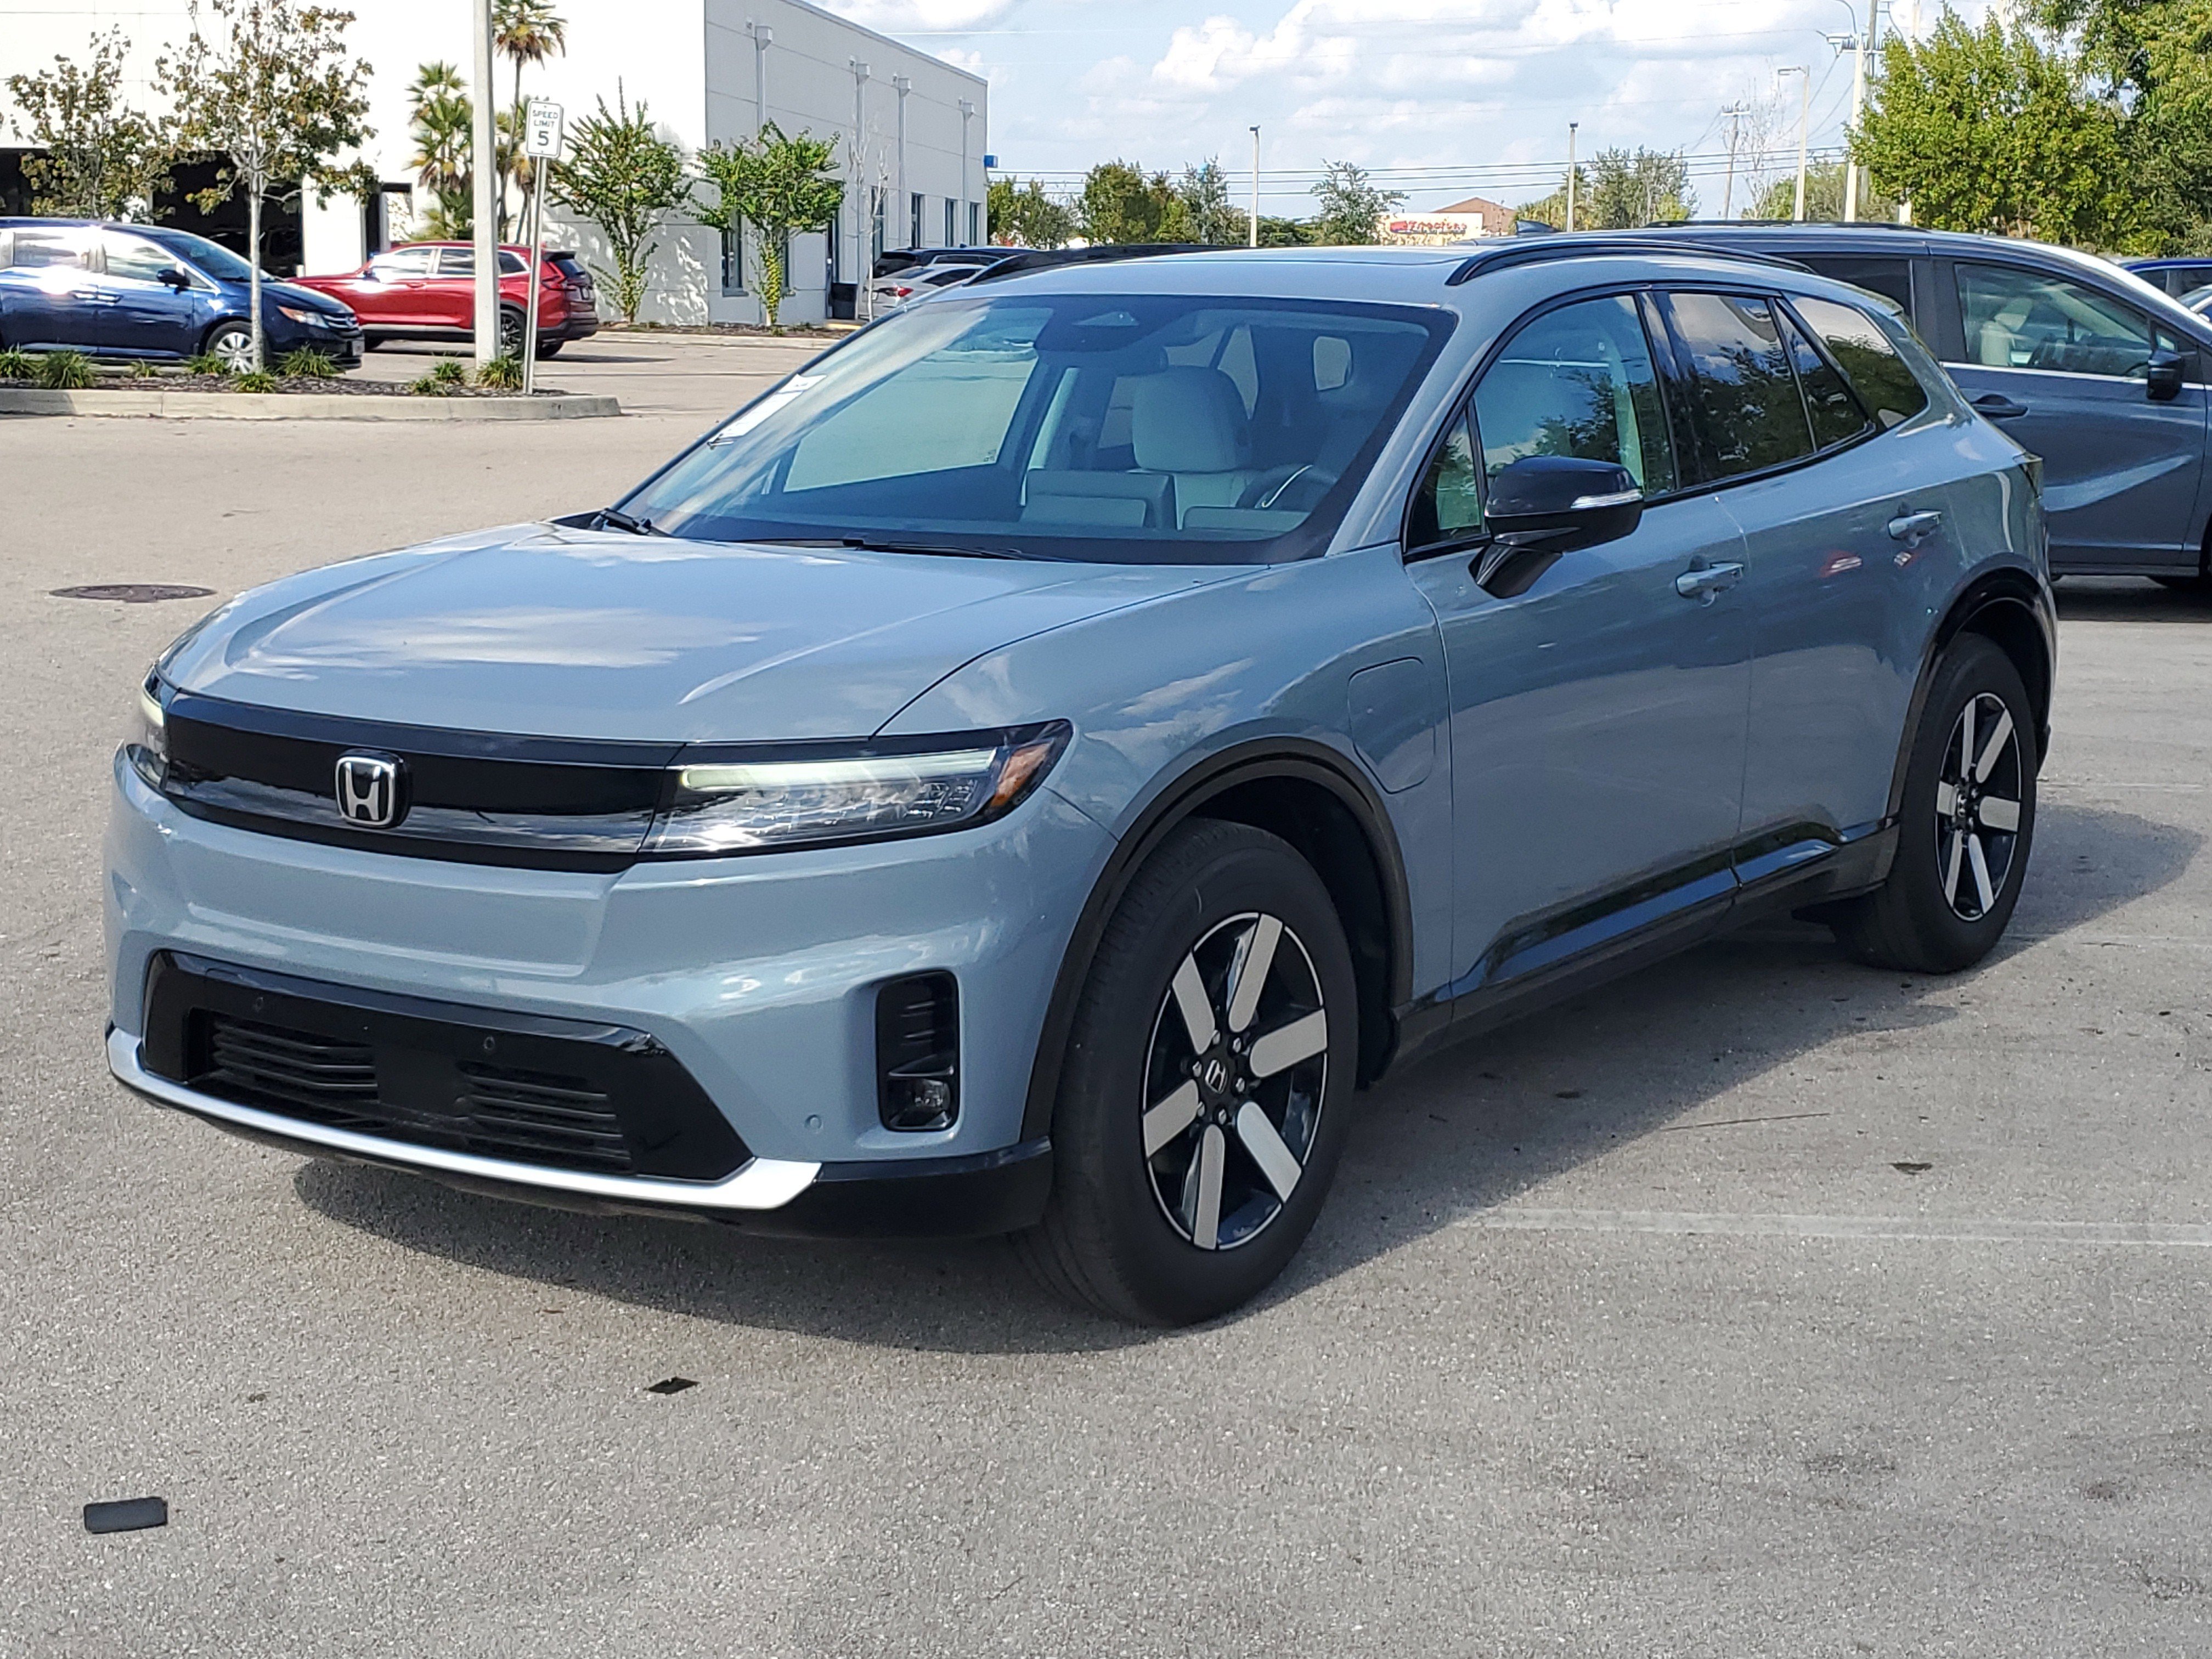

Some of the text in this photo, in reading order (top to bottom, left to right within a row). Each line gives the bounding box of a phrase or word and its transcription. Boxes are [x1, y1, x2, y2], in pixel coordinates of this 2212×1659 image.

[533, 110, 558, 119] SPEED
[534, 120, 555, 128] LIMIT
[537, 131, 549, 146] 5
